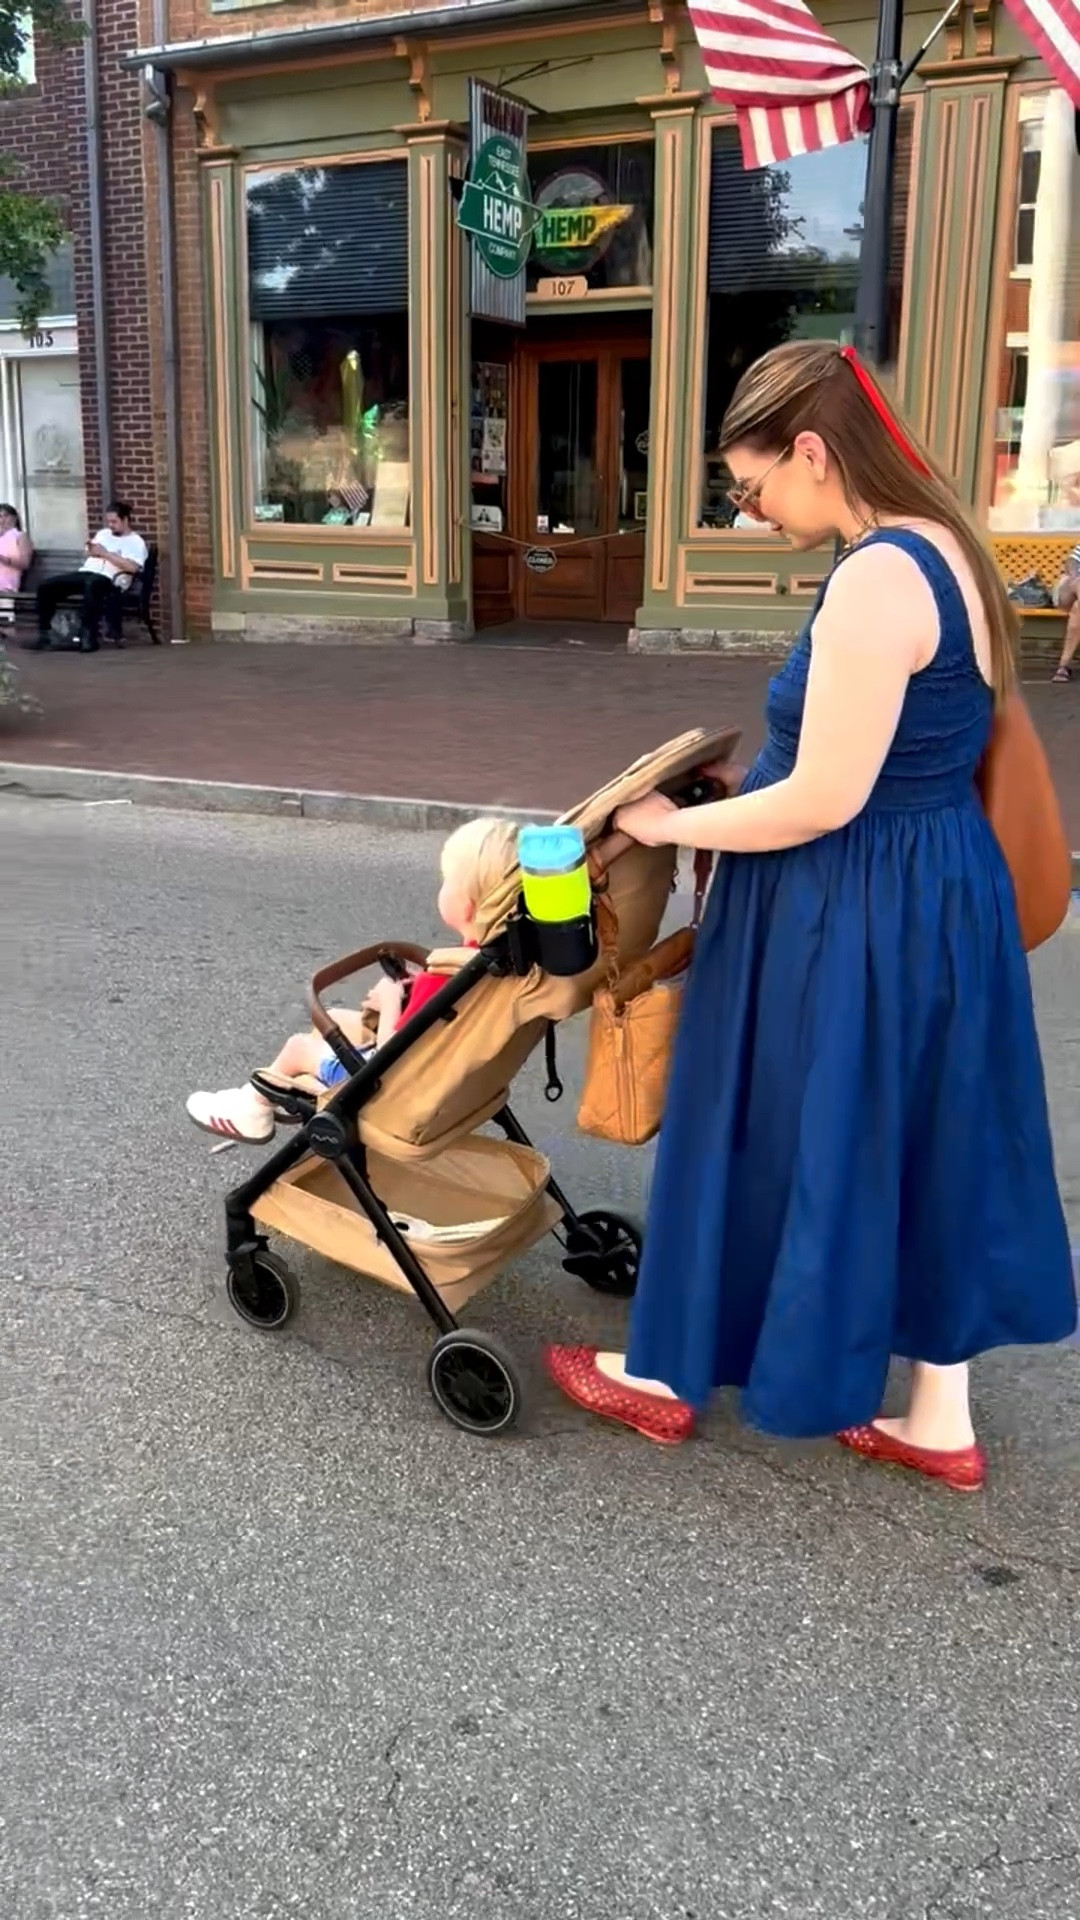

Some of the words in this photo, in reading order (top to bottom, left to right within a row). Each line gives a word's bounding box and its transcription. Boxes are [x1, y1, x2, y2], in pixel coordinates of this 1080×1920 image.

[484, 195, 522, 237] HEMP
[542, 215, 597, 243] HEMP
[552, 280, 575, 296] 107
[29, 330, 54, 348] 105
